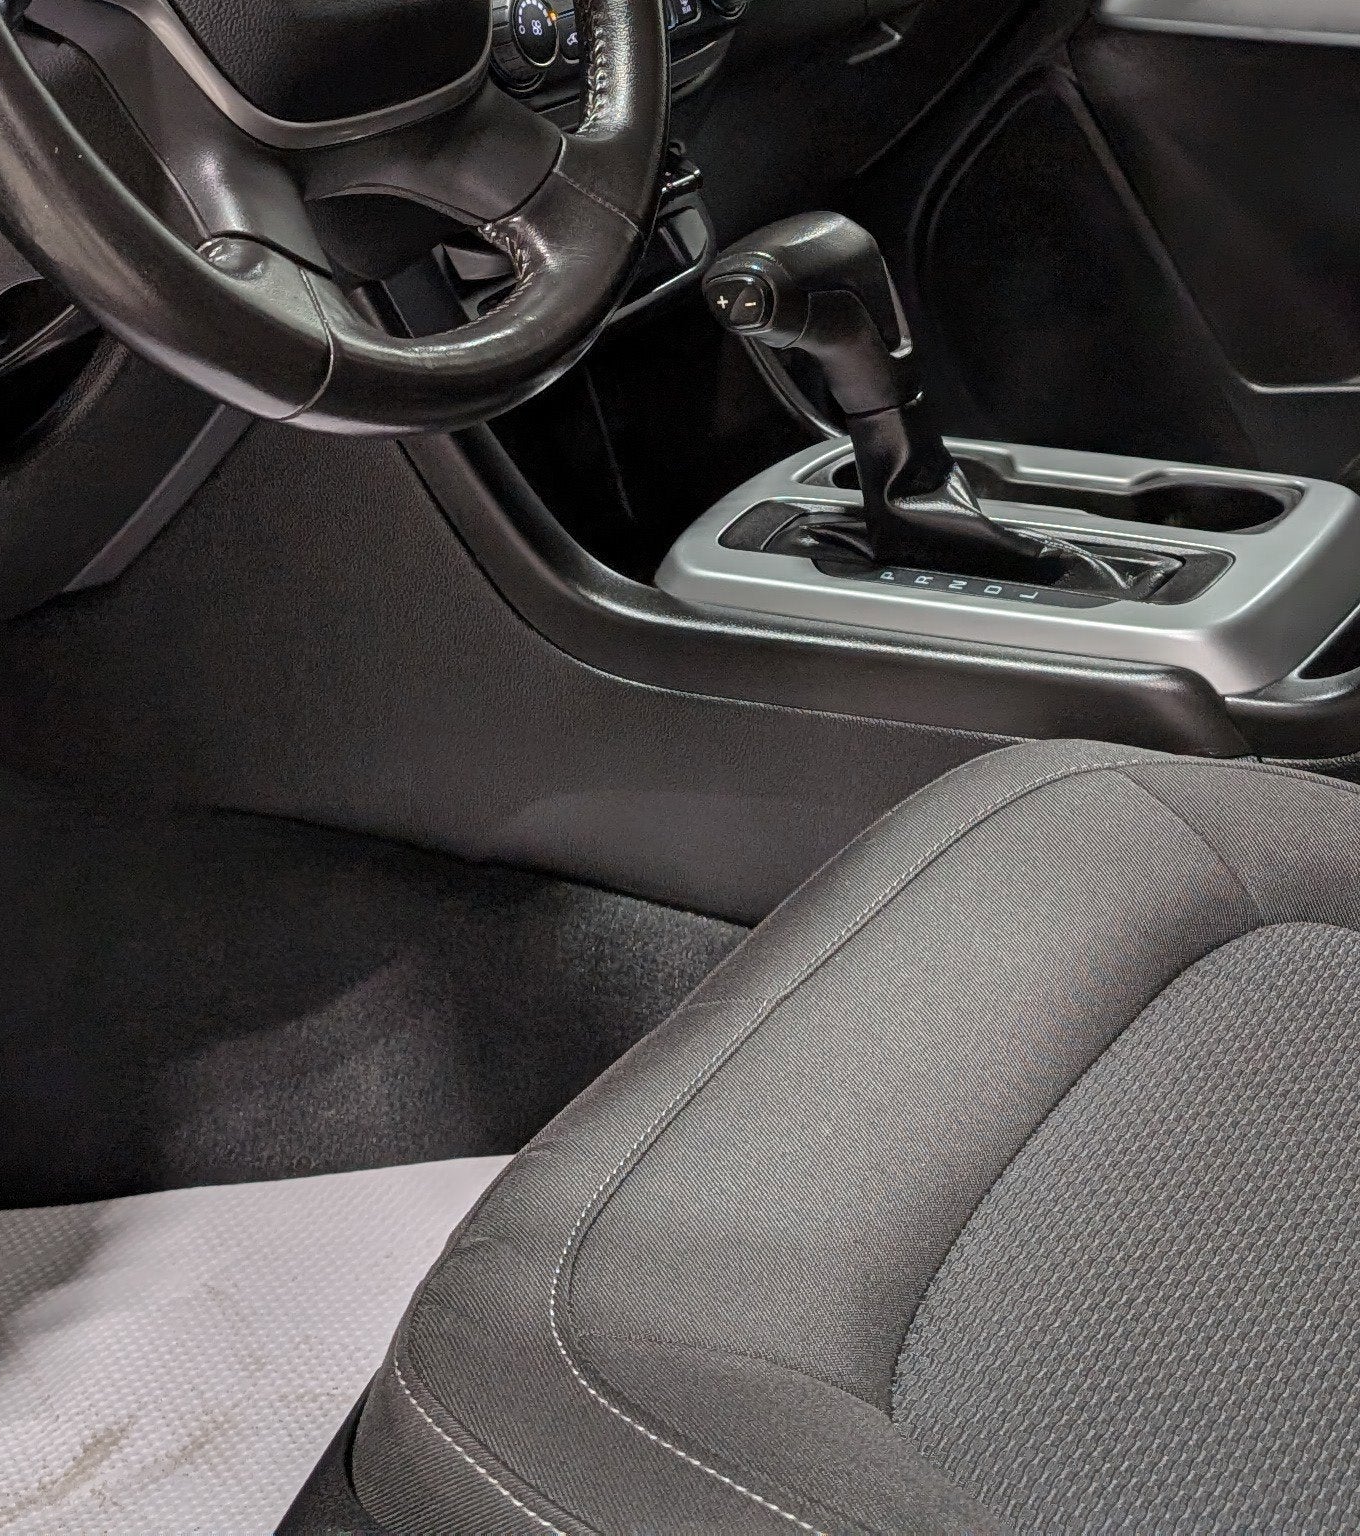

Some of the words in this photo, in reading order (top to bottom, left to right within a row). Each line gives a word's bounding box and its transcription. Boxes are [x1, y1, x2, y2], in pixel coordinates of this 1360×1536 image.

[880, 571, 895, 581] P
[914, 575, 934, 585] R
[948, 579, 968, 590] N
[984, 585, 1003, 595] D
[1019, 591, 1039, 600] L
